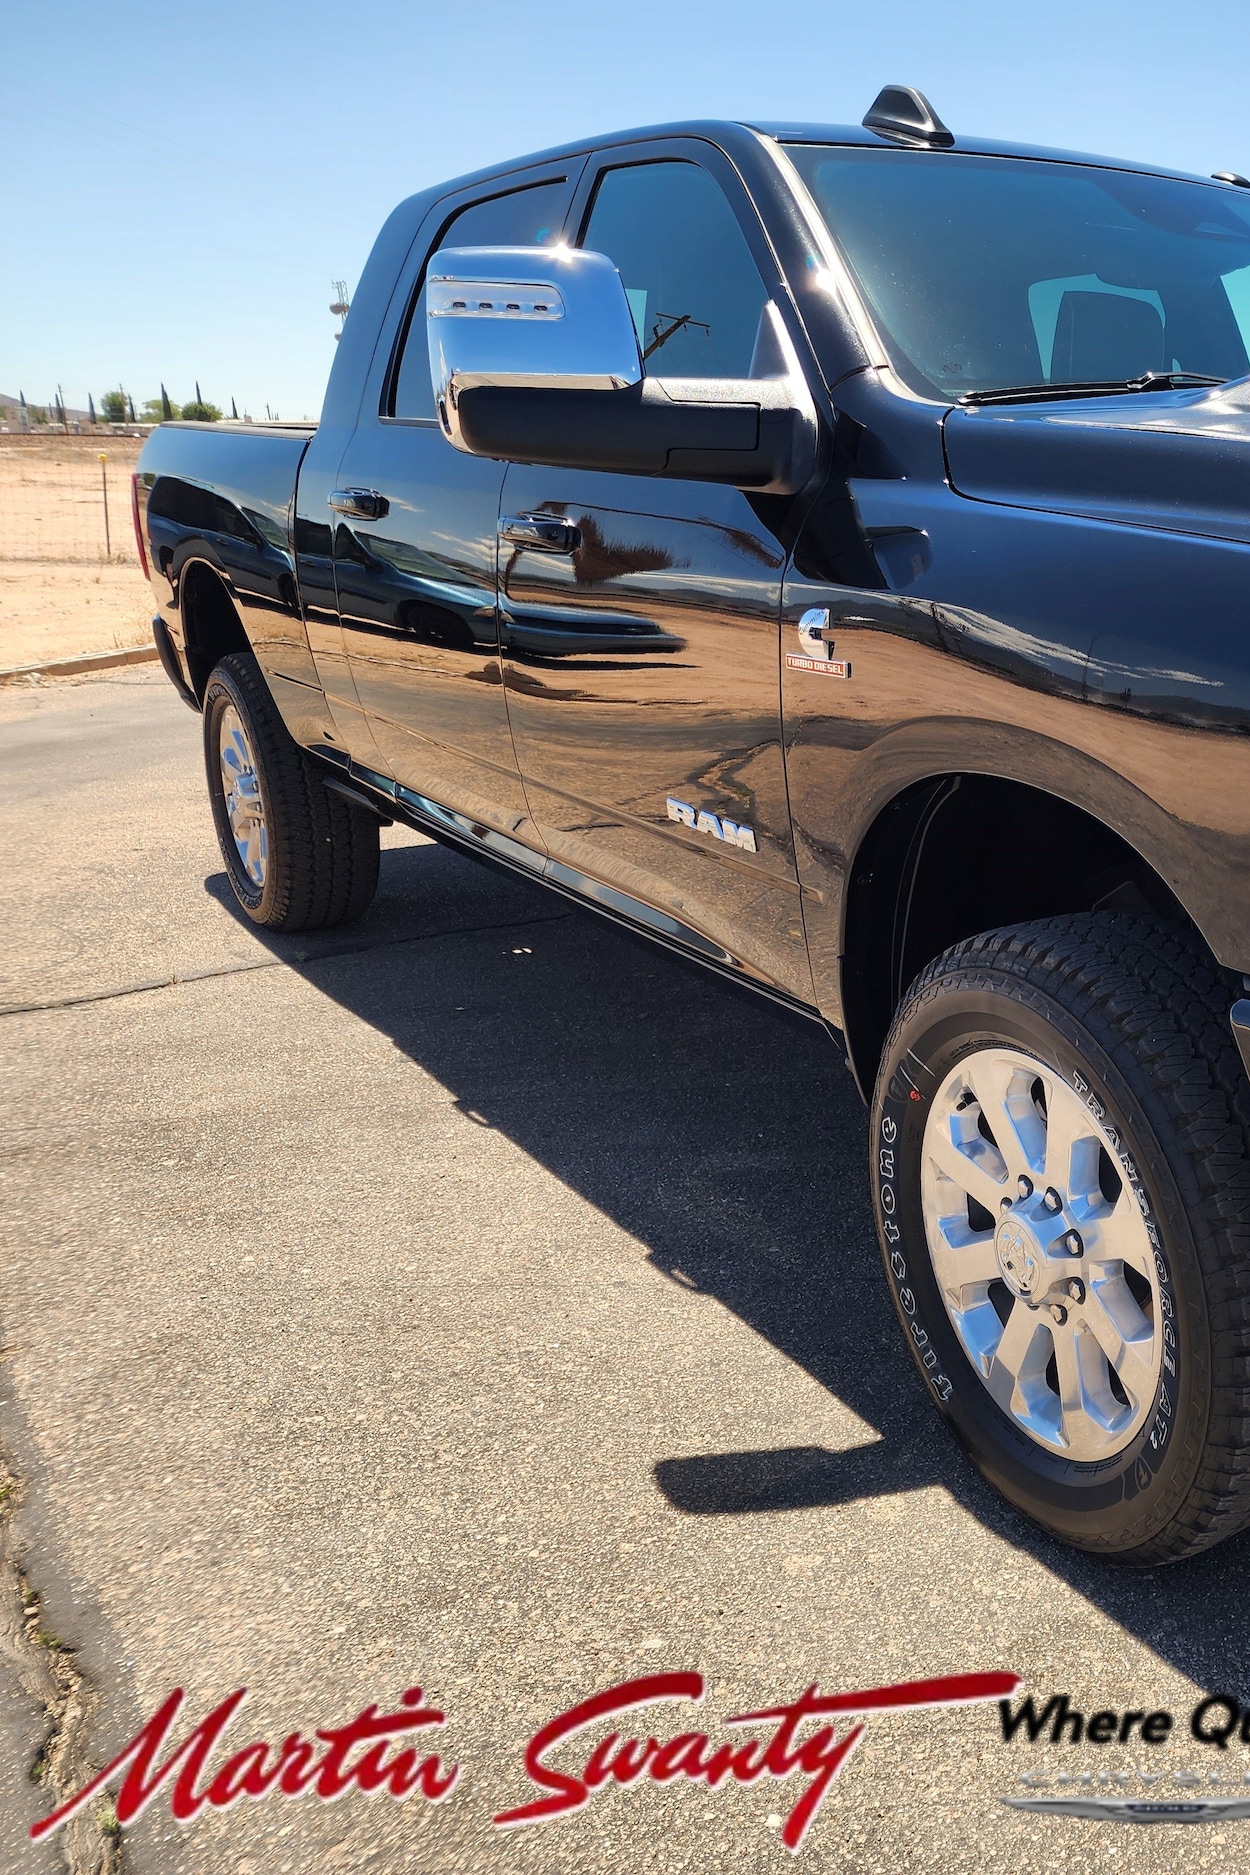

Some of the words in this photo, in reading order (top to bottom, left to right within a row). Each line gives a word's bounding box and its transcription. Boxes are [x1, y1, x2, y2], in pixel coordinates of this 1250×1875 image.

[787, 656, 814, 670] TURBO
[814, 661, 844, 676] DIESEL
[666, 797, 758, 854] RAM
